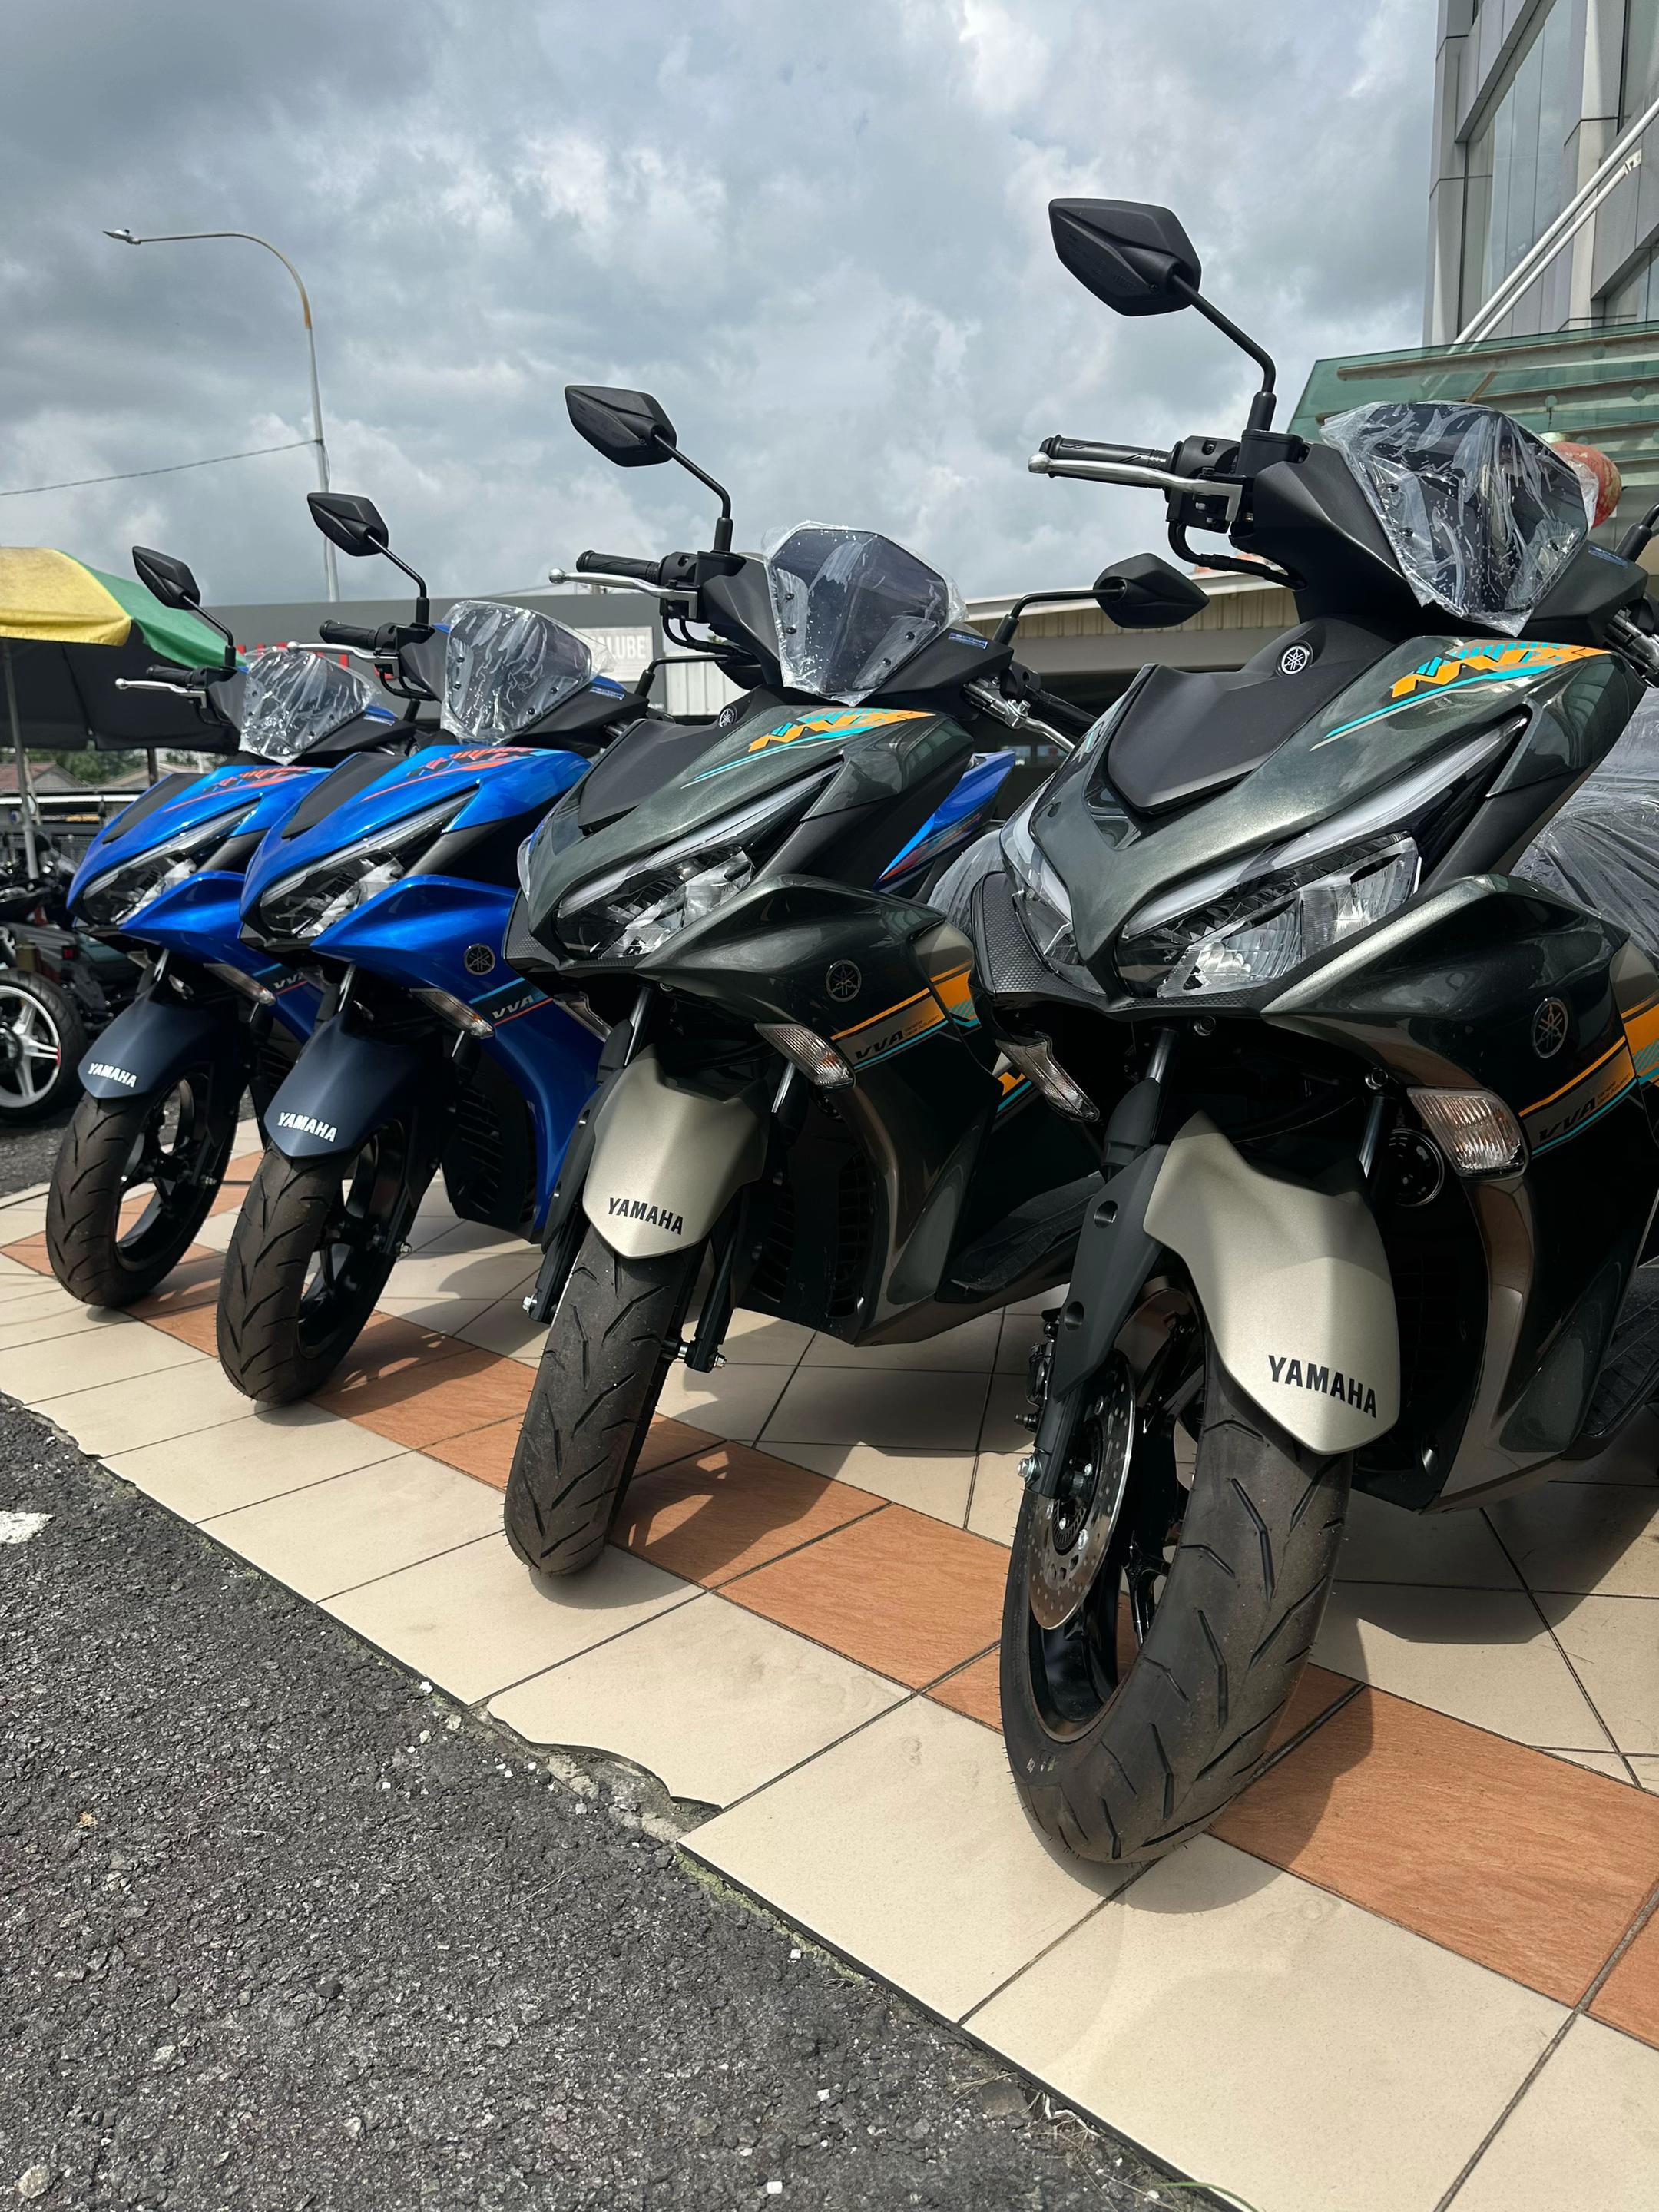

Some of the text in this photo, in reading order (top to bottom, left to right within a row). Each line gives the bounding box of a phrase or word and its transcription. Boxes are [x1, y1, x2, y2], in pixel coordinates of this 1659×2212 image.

[596, 635, 647, 659] LUBE
[492, 995, 535, 1019] VVA
[855, 1030, 905, 1060] VVA
[88, 1062, 137, 1088] YAMAHA
[277, 1111, 338, 1143] YAMAHA
[1539, 1097, 1596, 1142] VVA
[608, 1197, 684, 1236] YAMAHA
[1267, 1354, 1377, 1419] YAMAHA
